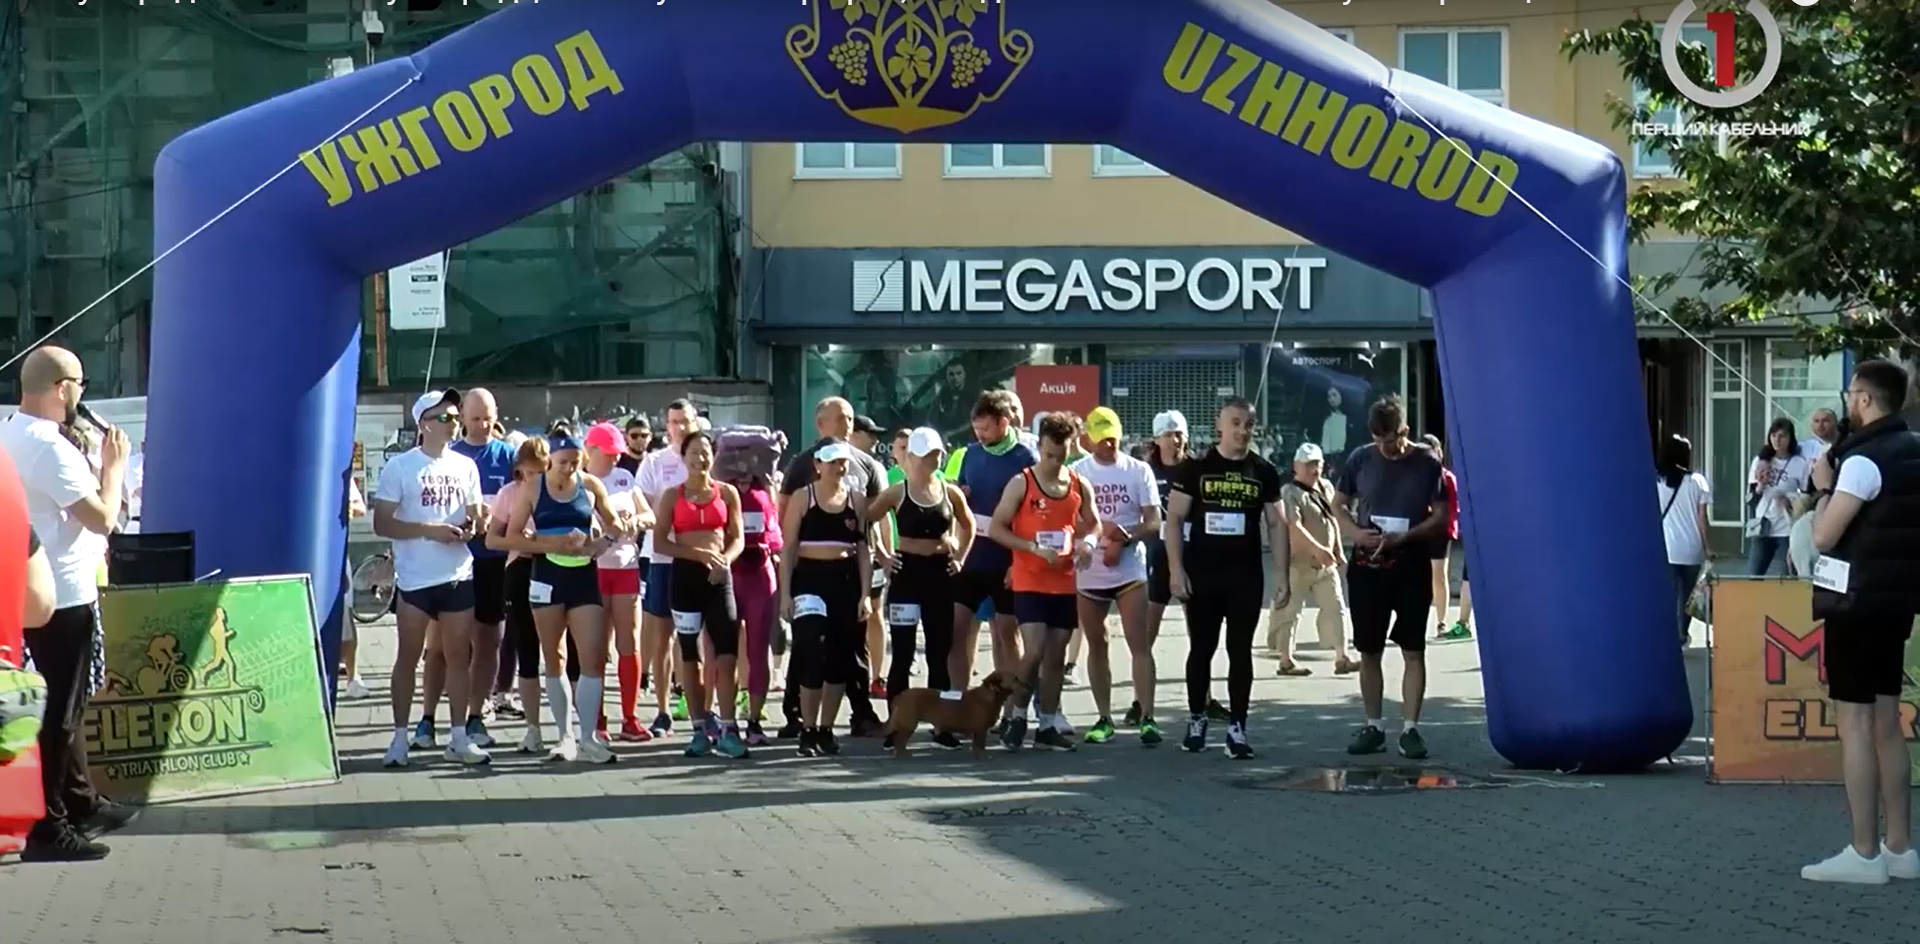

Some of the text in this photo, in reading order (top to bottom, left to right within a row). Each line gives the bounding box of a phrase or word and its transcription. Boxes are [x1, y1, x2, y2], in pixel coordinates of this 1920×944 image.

[299, 31, 623, 206] УЖГОРОД
[1163, 21, 1518, 219] UZHHOROD
[910, 258, 1327, 311] MEGASPORT
[1292, 356, 1341, 366] АВТОСПОРТ
[1039, 382, 1077, 395] Акція
[420, 474, 462, 485] ТВОРИ
[1220, 498, 1242, 509] 2021
[119, 750, 237, 778] TRIATHLON CLUB
